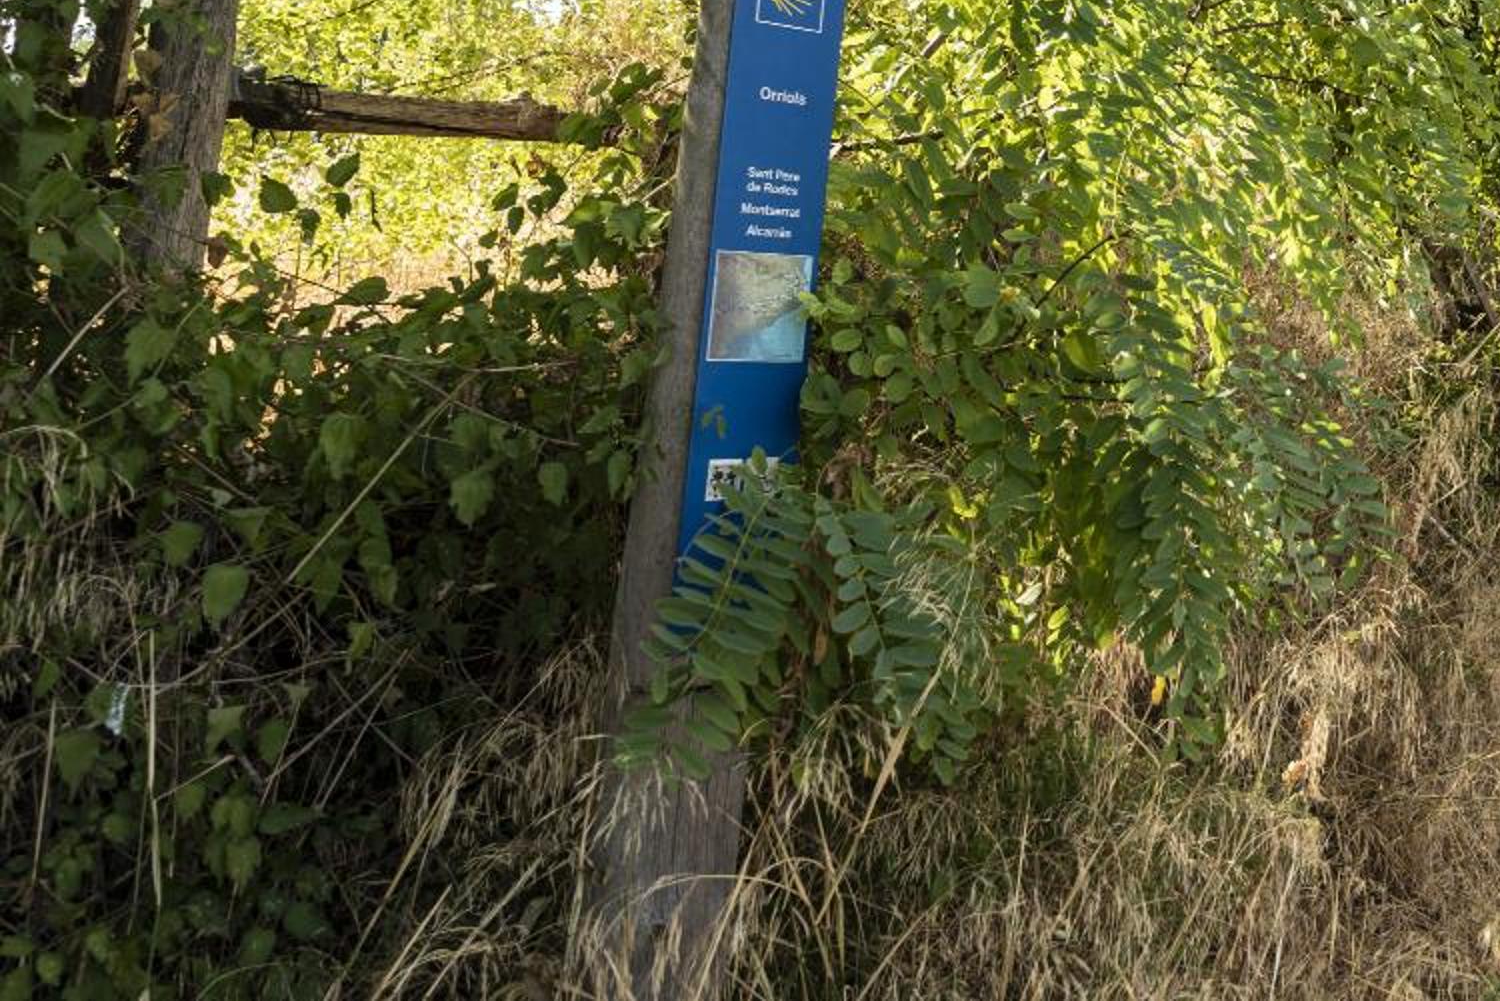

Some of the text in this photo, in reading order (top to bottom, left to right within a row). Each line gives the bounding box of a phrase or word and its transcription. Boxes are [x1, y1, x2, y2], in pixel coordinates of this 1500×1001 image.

[759, 86, 808, 106] Orriols
[747, 166, 801, 182] Sant Pere
[746, 181, 800, 196] de Rodes
[740, 202, 801, 218] Montserrat
